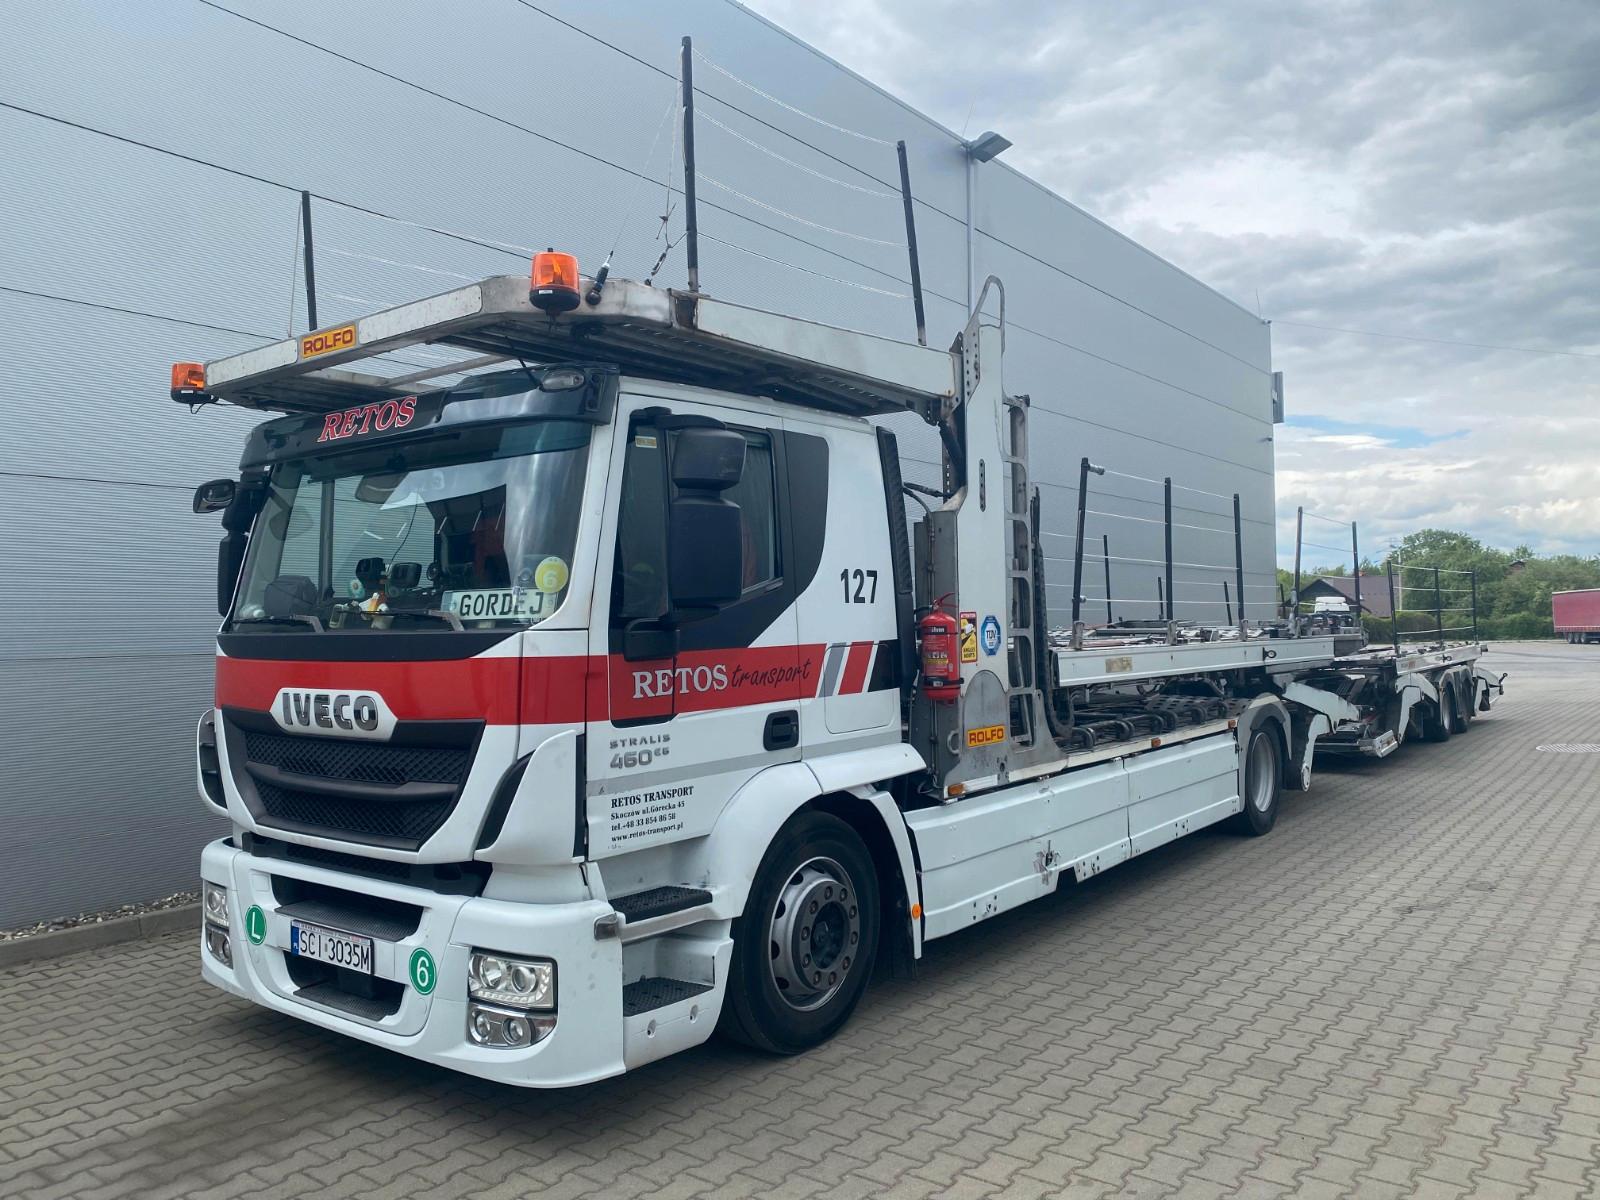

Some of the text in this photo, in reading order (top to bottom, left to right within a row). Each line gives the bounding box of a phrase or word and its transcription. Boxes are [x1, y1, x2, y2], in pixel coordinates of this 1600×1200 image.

[303, 328, 354, 356] ROLFO
[317, 396, 417, 442] RETOS
[841, 568, 878, 604] 127
[459, 590, 545, 617] GORDEJ
[632, 658, 811, 699] RETOS transport
[282, 692, 379, 731] IVECO
[610, 733, 671, 749] STRALIS
[968, 728, 1004, 745] ROLFO
[610, 750, 653, 769] 460
[611, 786, 694, 809] RETOS TRANSPORT
[636, 819, 644, 827] 33
[252, 911, 261, 940] L
[300, 930, 321, 958] SCI
[328, 938, 370, 971] 3035M
[416, 955, 430, 987] 6
